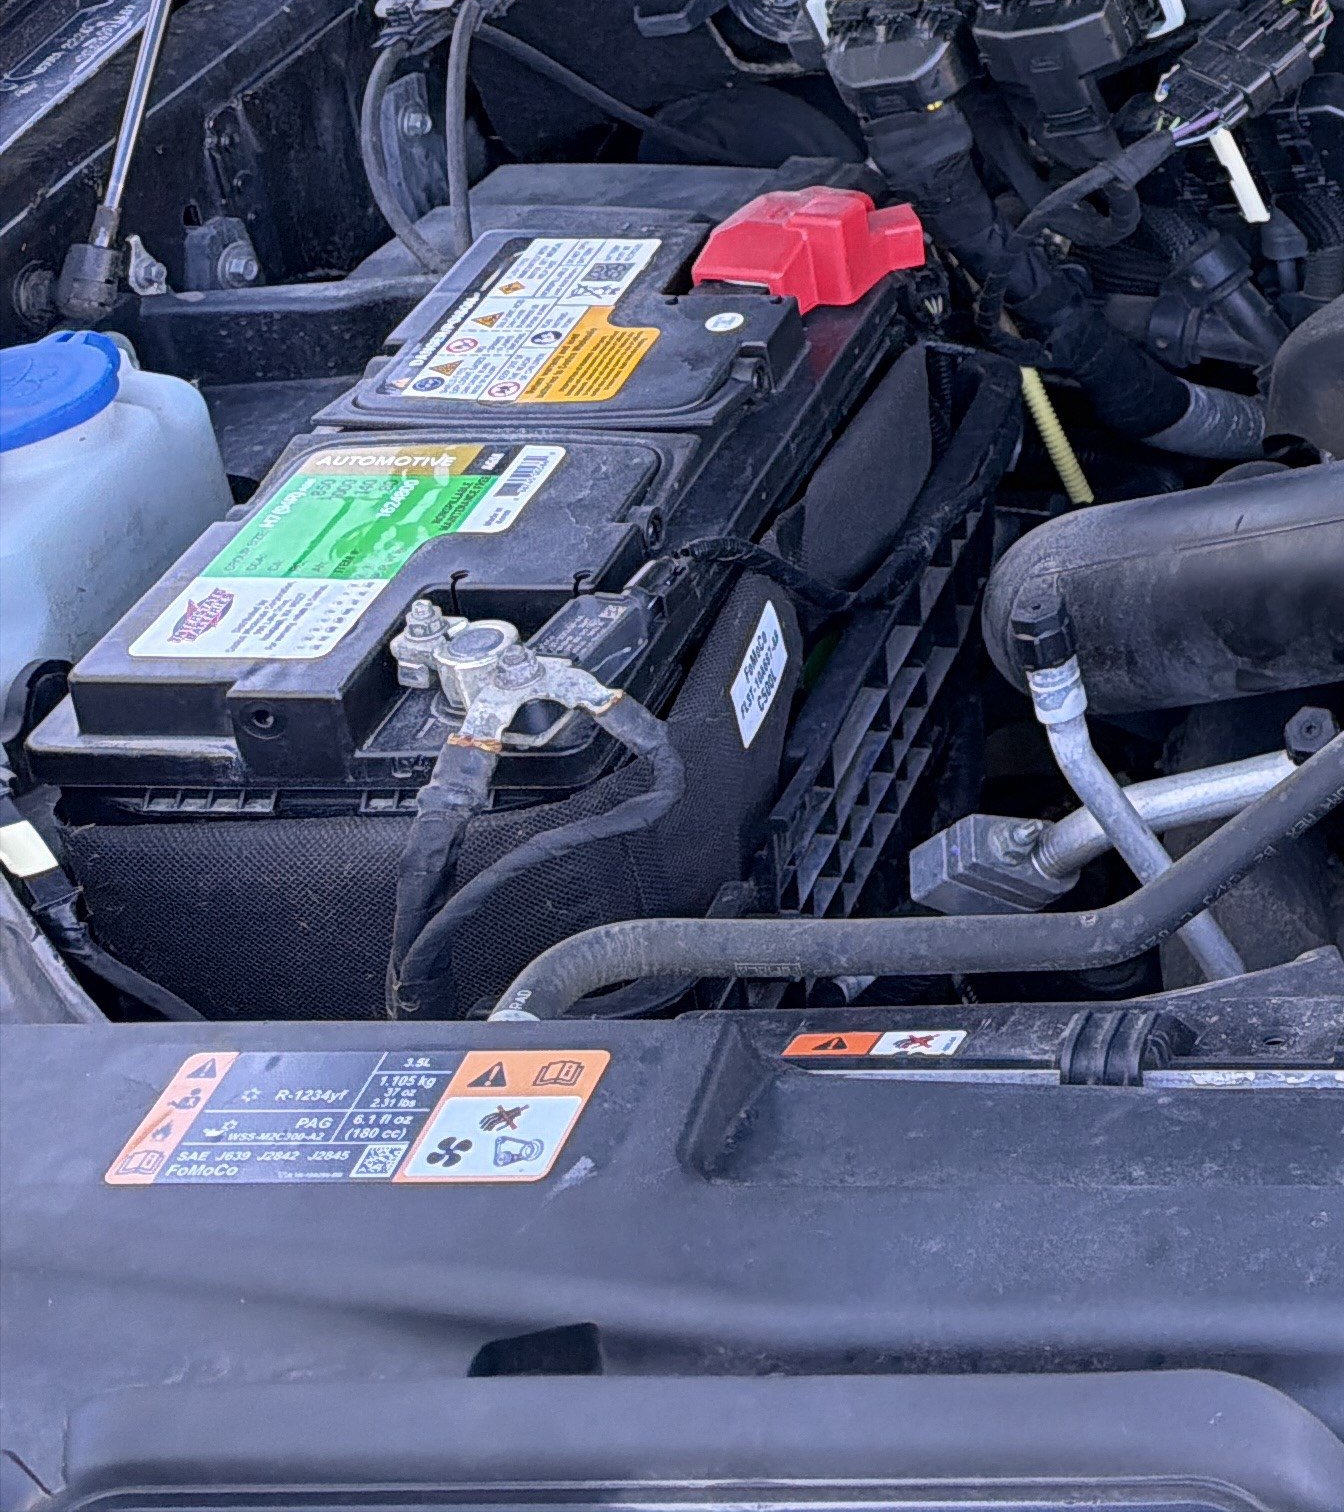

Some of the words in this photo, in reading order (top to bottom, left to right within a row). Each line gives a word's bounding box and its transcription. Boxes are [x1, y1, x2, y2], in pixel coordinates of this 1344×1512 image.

[315, 454, 457, 467] AUTOMOTIVE
[743, 631, 768, 683] FoMoCo
[402, 1057, 431, 1068] 3.5L
[379, 1076, 417, 1087] 1.105
[418, 1075, 437, 1089] kg
[274, 1088, 349, 1103] R-1234yf
[384, 1088, 398, 1097] 37
[370, 1099, 397, 1108] 2.31
[398, 1099, 416, 1108] lbs
[295, 1117, 333, 1129] PAG
[352, 1115, 377, 1125] 6.1
[379, 1115, 391, 1125] fl
[393, 1116, 413, 1125] oz
[344, 1128, 378, 1140] (180
[381, 1129, 408, 1140] cc)
[176, 1150, 210, 1162] SAE
[214, 1150, 251, 1162] J639
[256, 1150, 300, 1162] J2842
[307, 1150, 350, 1162] J2845
[164, 1163, 239, 1177] FoMoCo
